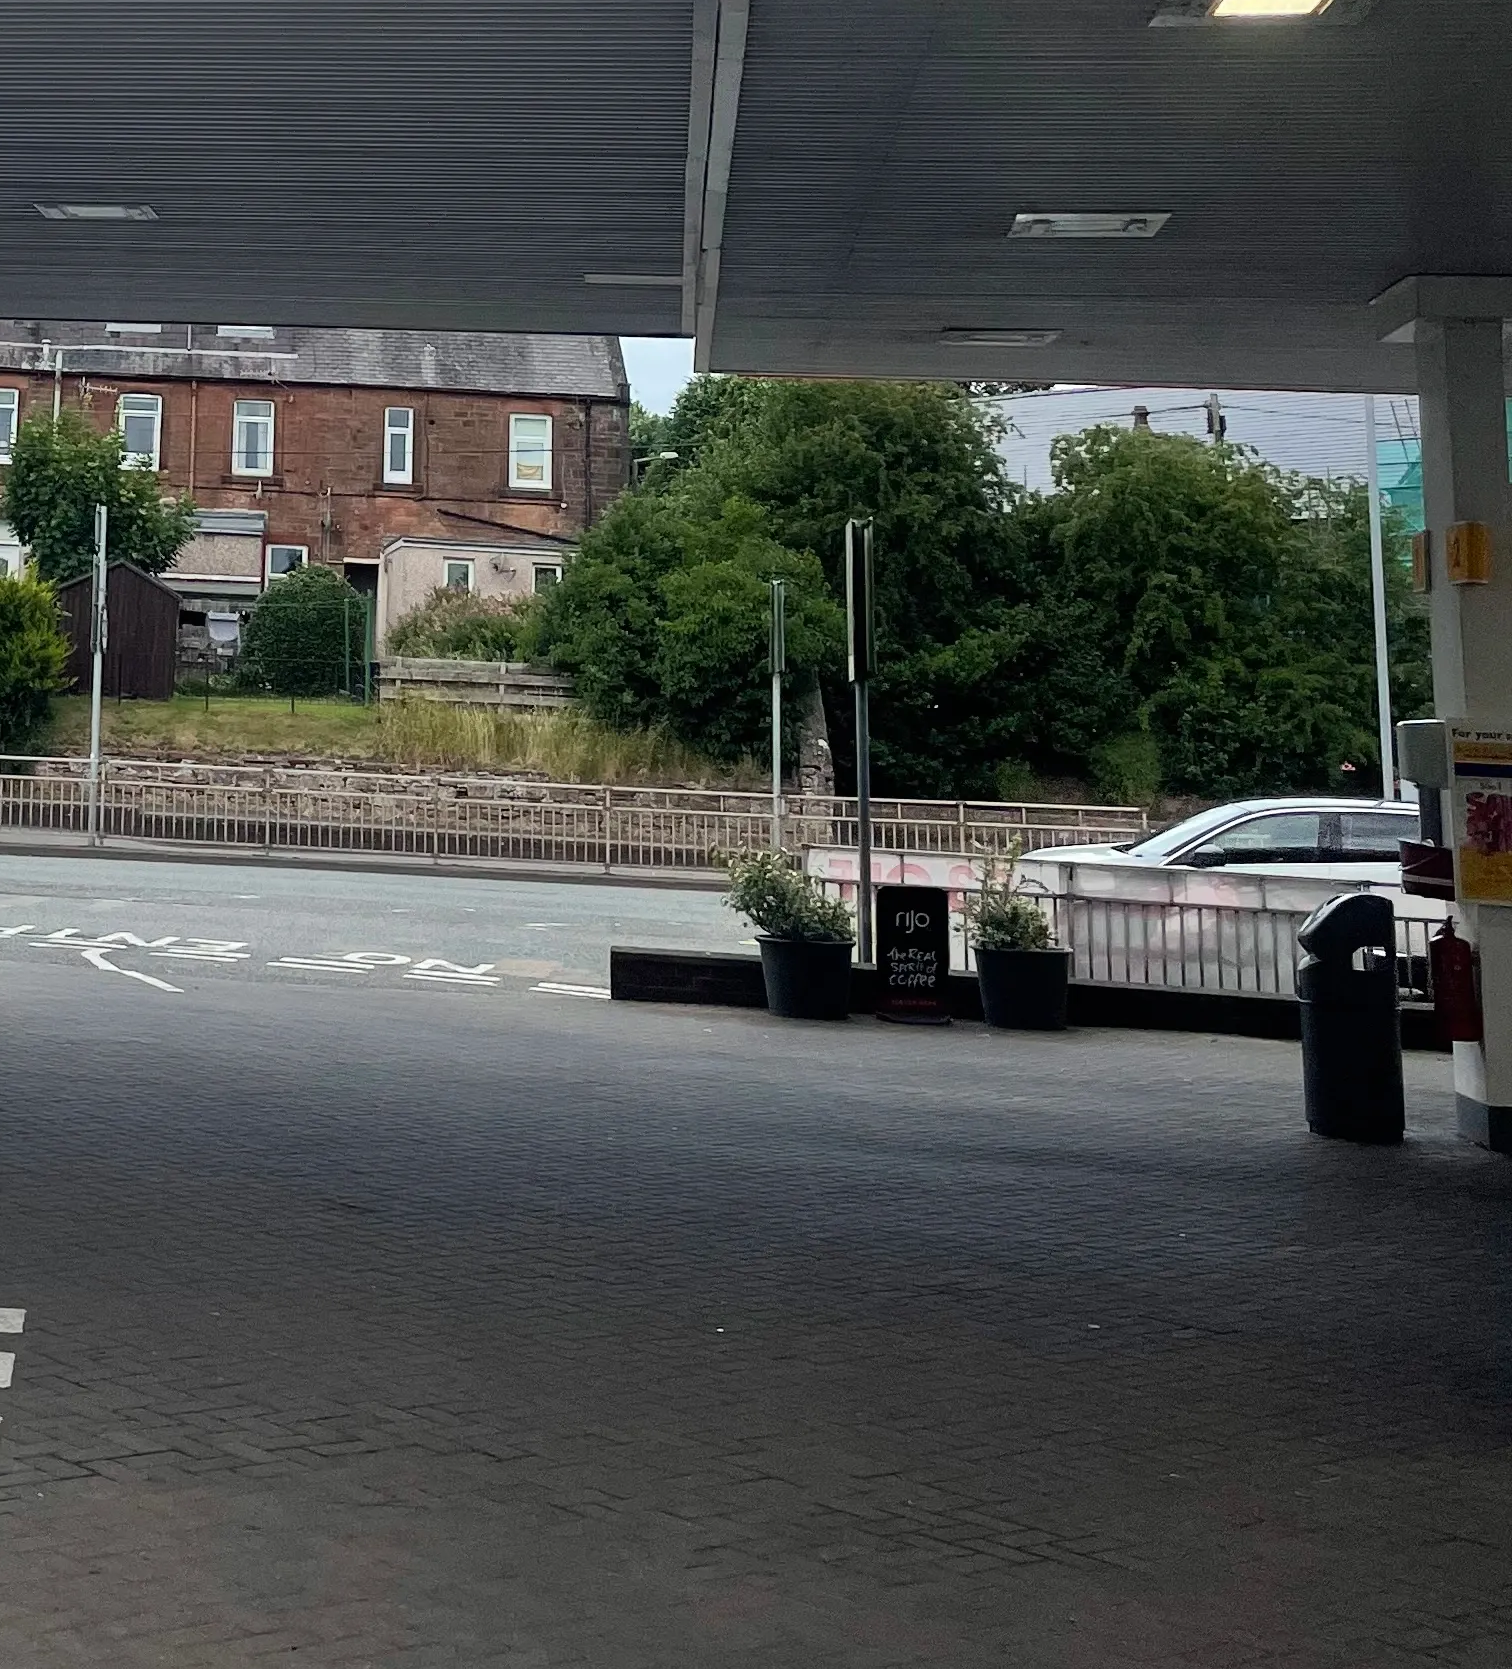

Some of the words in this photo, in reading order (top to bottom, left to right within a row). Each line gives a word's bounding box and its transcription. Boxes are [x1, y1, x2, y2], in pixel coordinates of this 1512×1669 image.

[1451, 727, 1471, 738] For
[1475, 730, 1503, 742] your
[342, 951, 496, 975] NO
